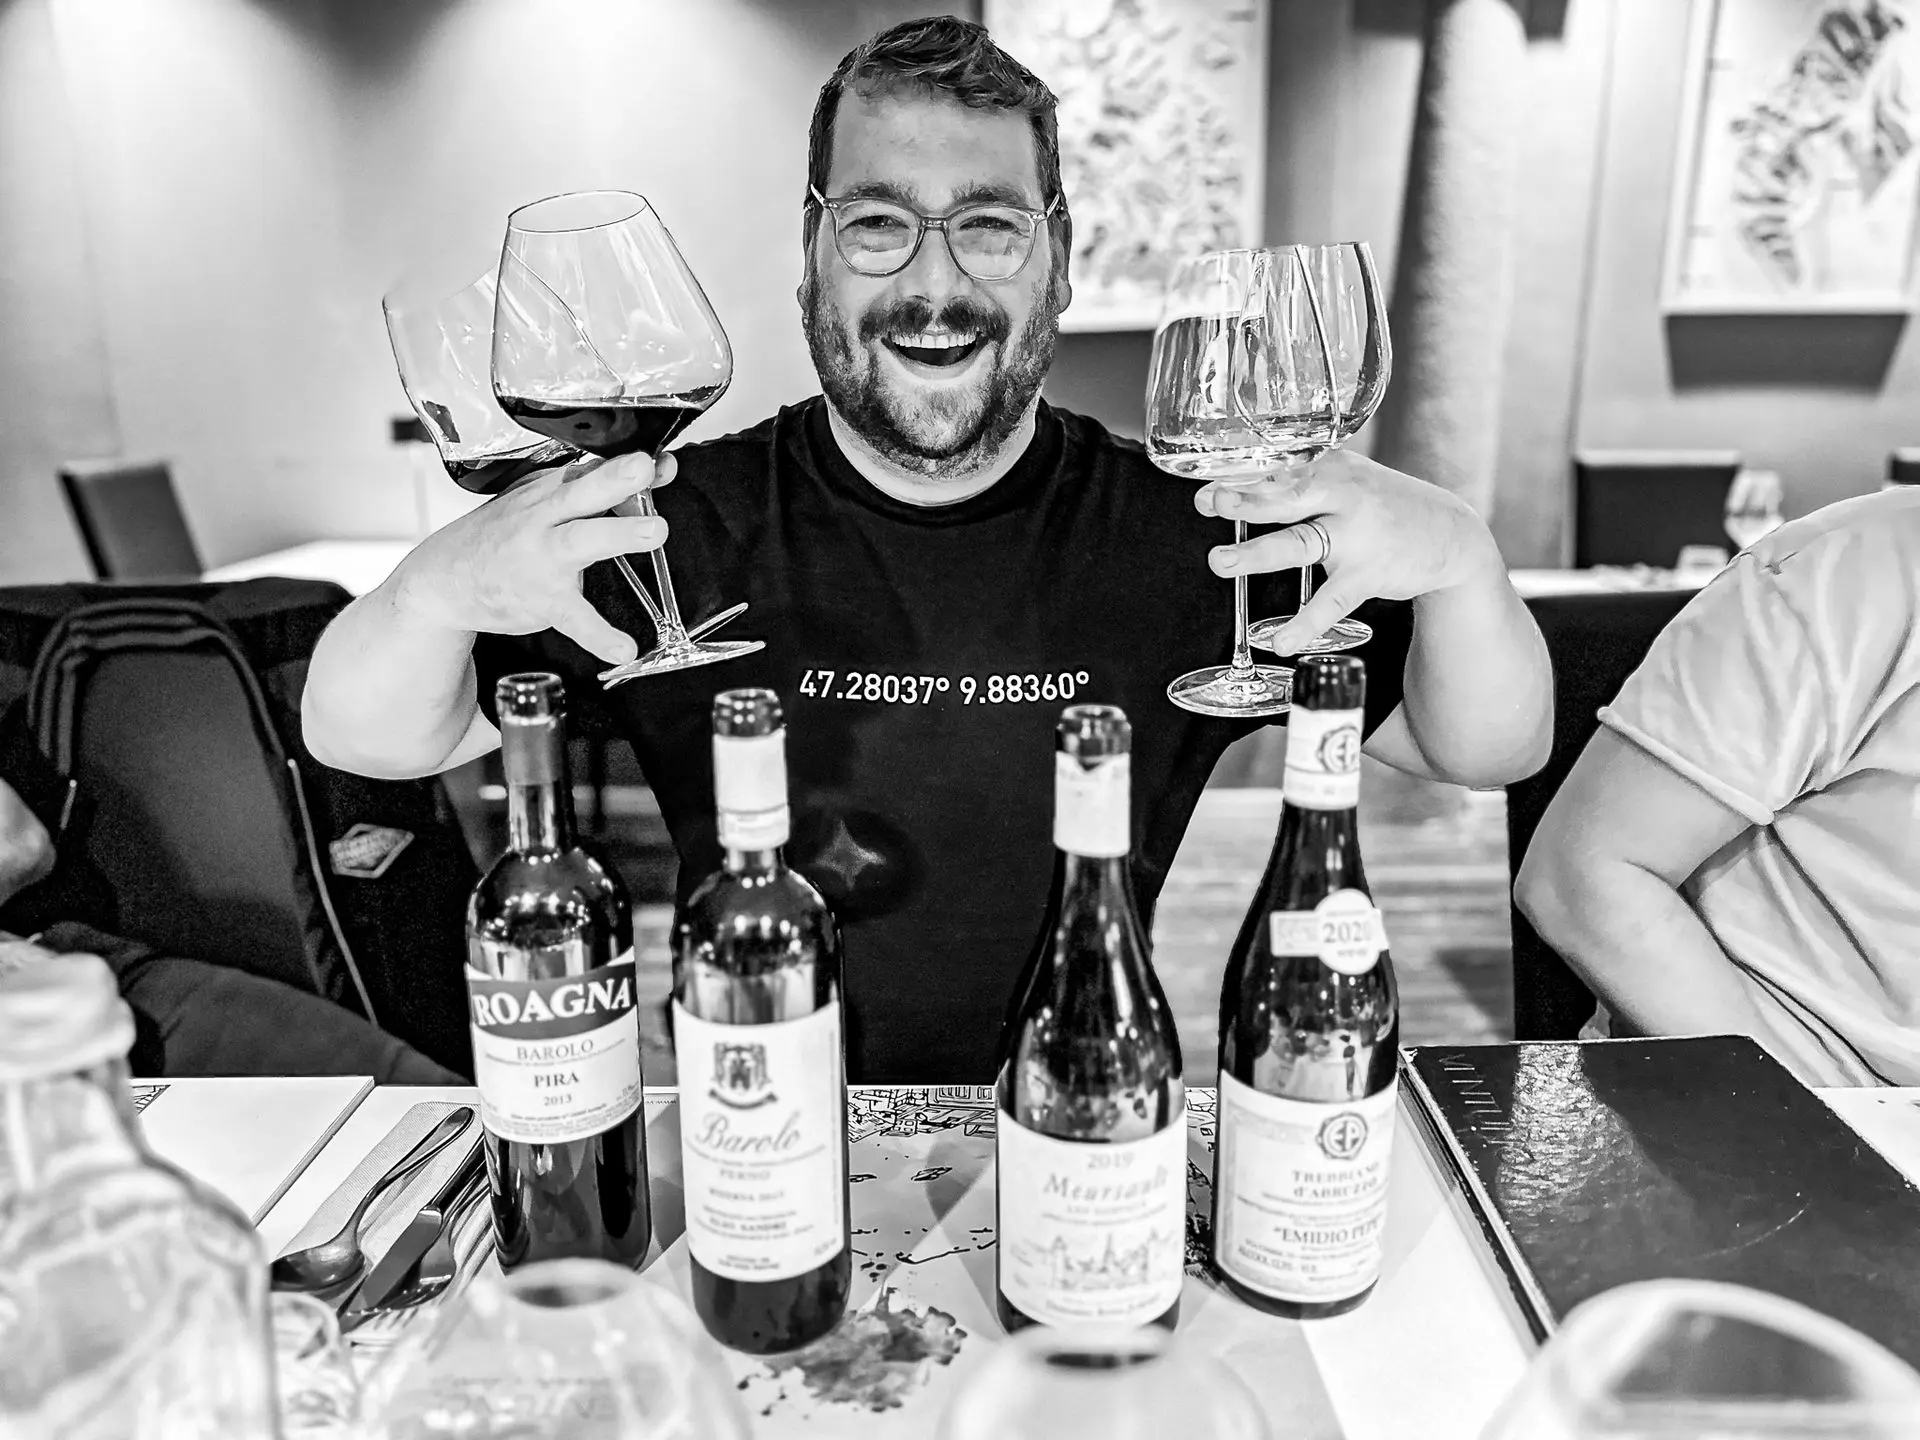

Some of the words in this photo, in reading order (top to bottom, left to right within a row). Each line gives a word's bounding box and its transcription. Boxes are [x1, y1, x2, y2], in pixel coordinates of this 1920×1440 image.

[800, 669, 950, 704] 47.28037°
[959, 671, 1090, 704] 9.88360°
[472, 977, 632, 1027] ROAGNA
[516, 1039, 594, 1061] BAROLO
[534, 1072, 579, 1088] PIRA
[543, 1093, 572, 1106] 2013
[695, 1110, 801, 1153] Barolo
[1087, 1152, 1134, 1169] 2019
